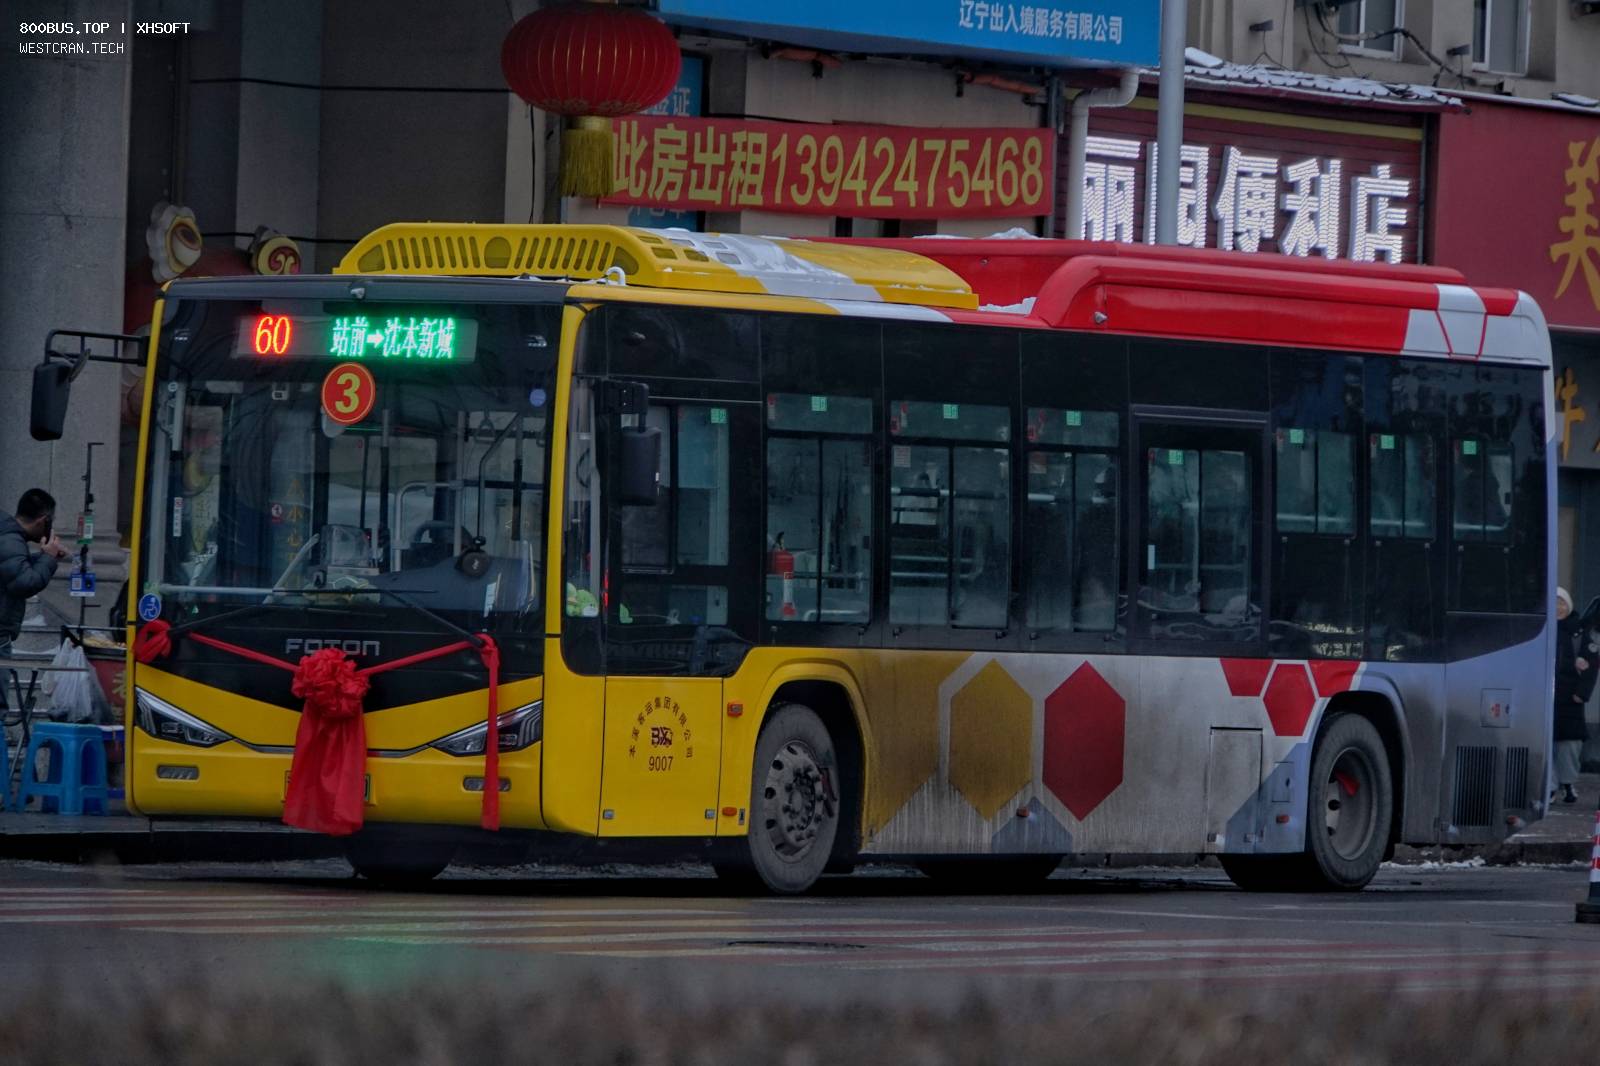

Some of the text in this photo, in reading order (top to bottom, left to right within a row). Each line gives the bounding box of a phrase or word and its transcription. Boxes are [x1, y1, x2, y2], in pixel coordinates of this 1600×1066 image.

[958, 1, 1123, 45] 辽宁出入境服务有限公司
[254, 315, 291, 354] 60
[334, 372, 361, 414] 3
[285, 638, 381, 656] FOTON
[648, 756, 673, 772] 9007
